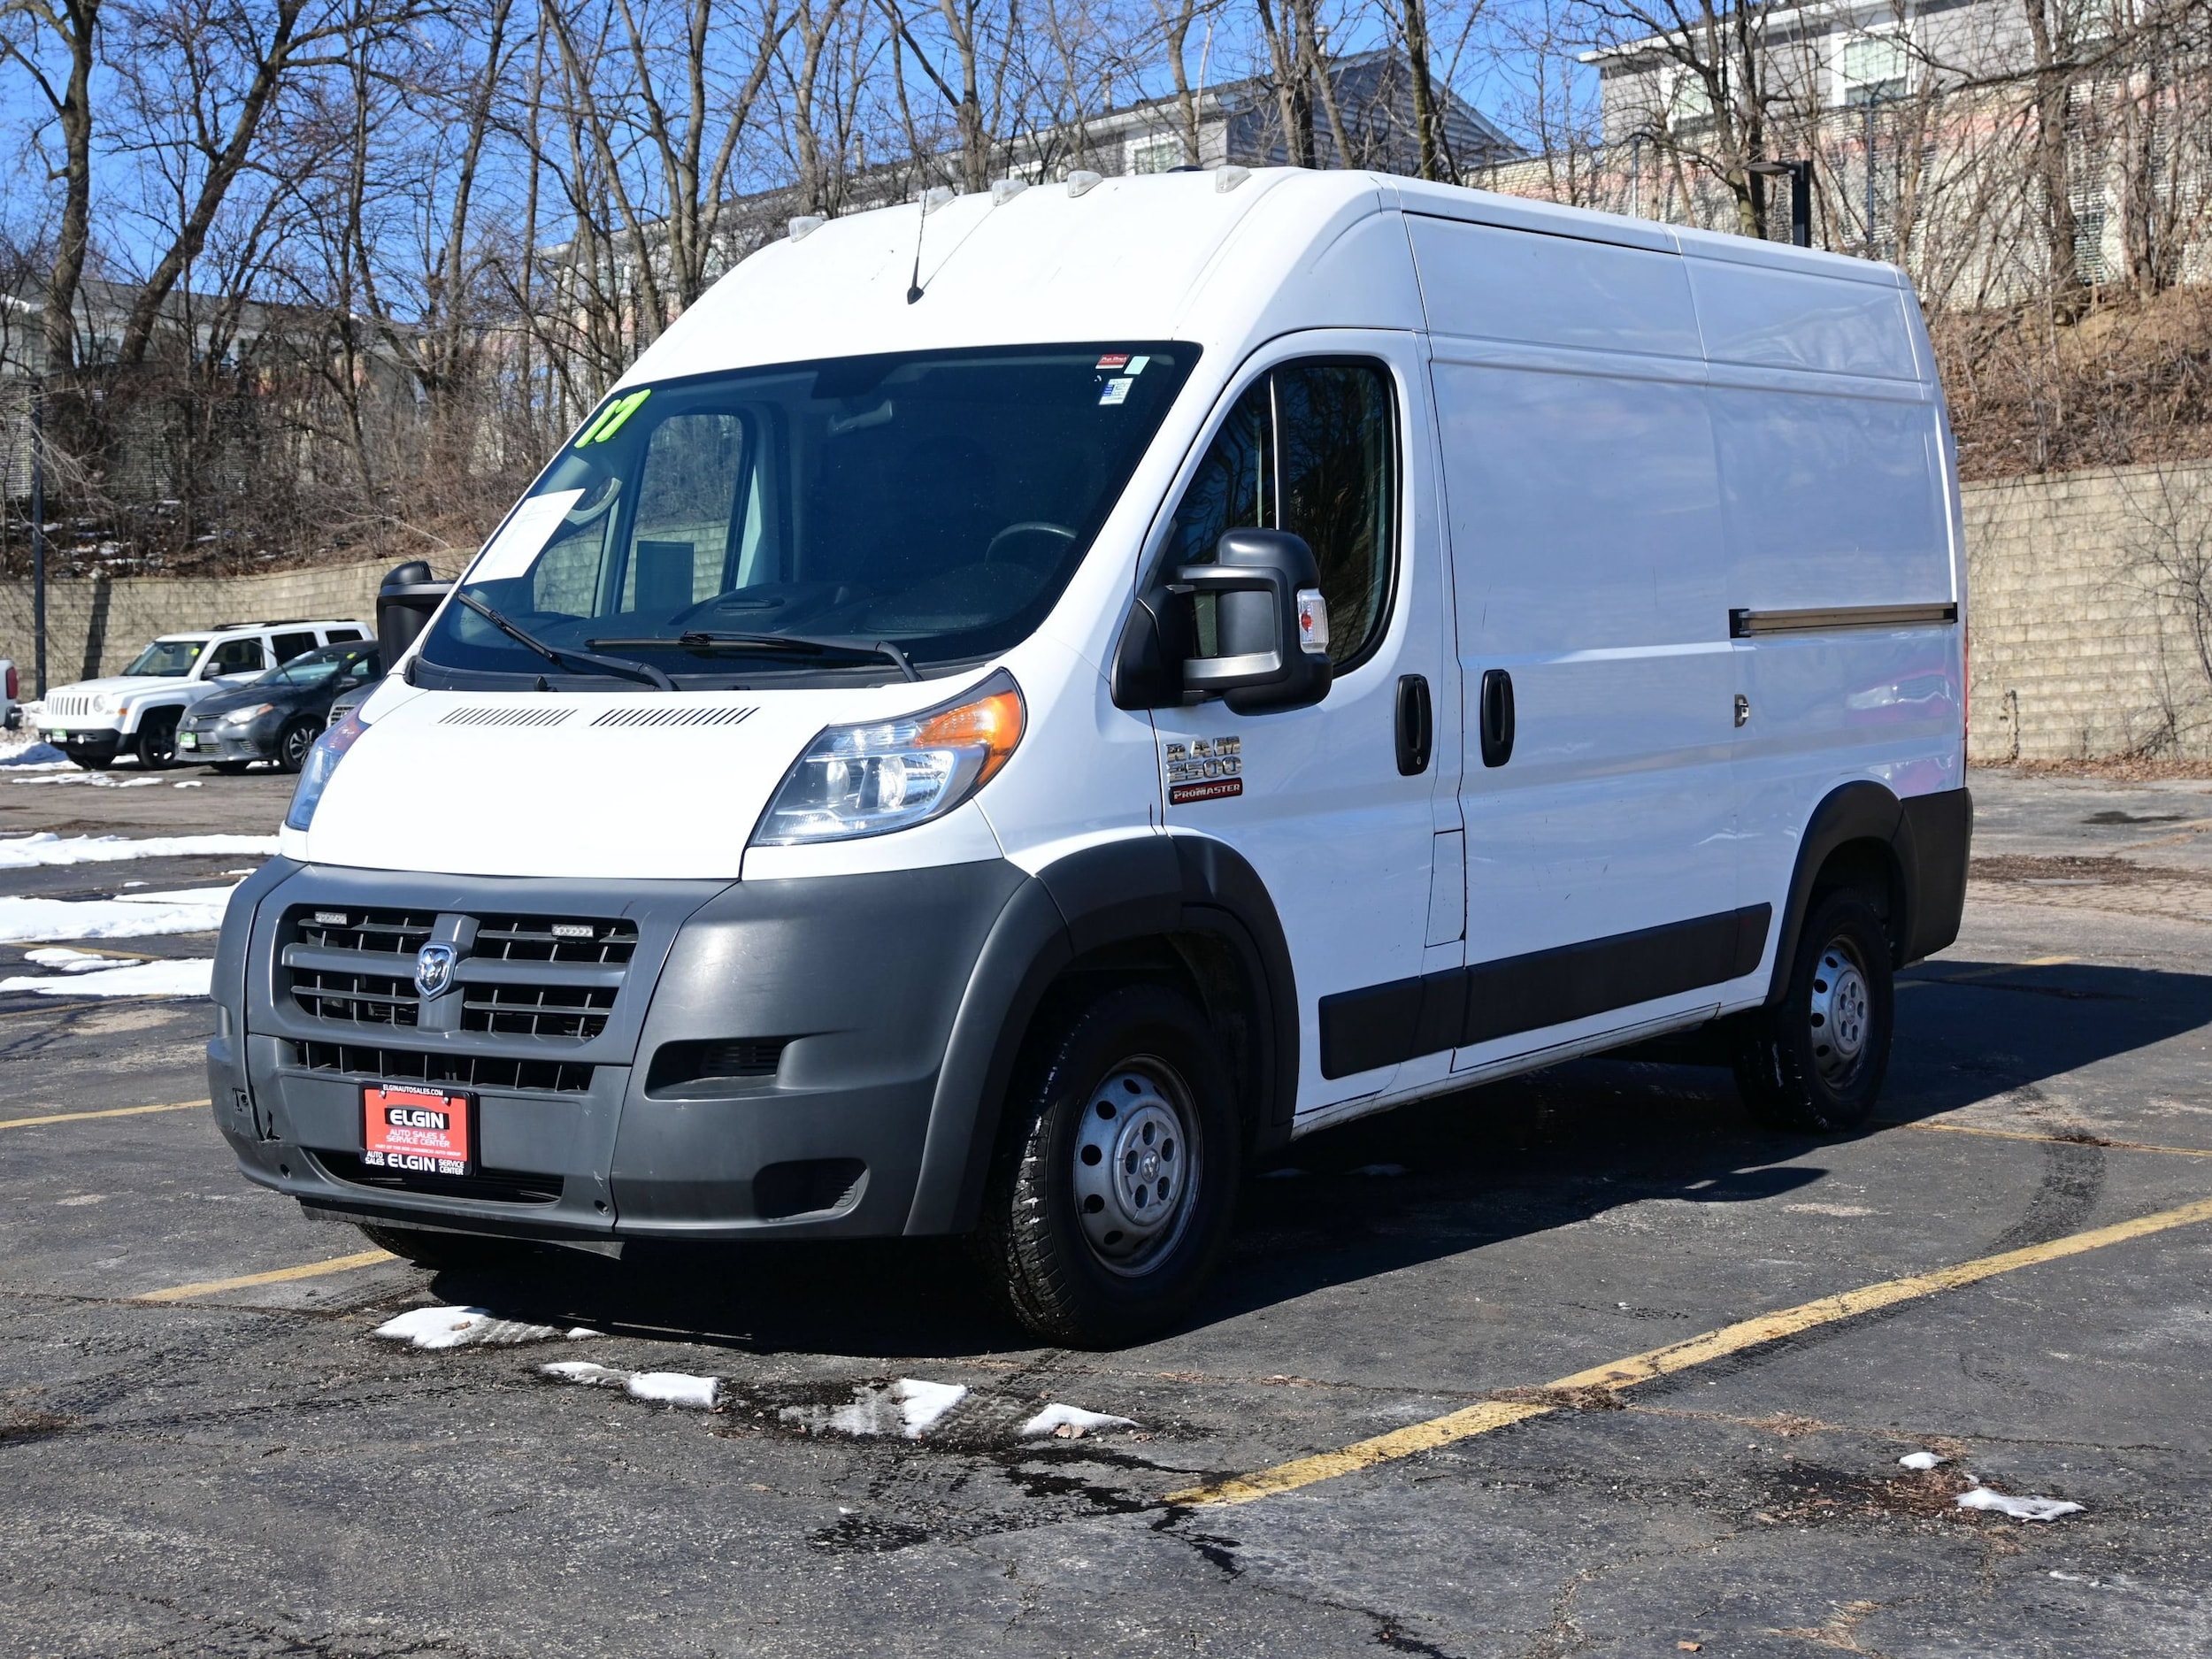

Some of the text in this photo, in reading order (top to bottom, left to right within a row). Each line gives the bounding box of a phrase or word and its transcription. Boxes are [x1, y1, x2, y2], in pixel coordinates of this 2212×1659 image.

[574, 388, 651, 449] 17
[1166, 736, 1240, 762] RAM
[1166, 757, 1241, 783] 2500
[383, 1084, 443, 1096] ELGINAUTOSALES.COM
[389, 1110, 444, 1129] ELGIN
[386, 1135, 450, 1148] SERVICE CENTER
[412, 1131, 438, 1140] SALES
[366, 1150, 383, 1159] AUTO
[365, 1156, 385, 1166] SALES
[388, 1153, 436, 1172] ELGIN
[438, 1159, 465, 1169] SERVICE
[439, 1166, 464, 1176] CENTER
